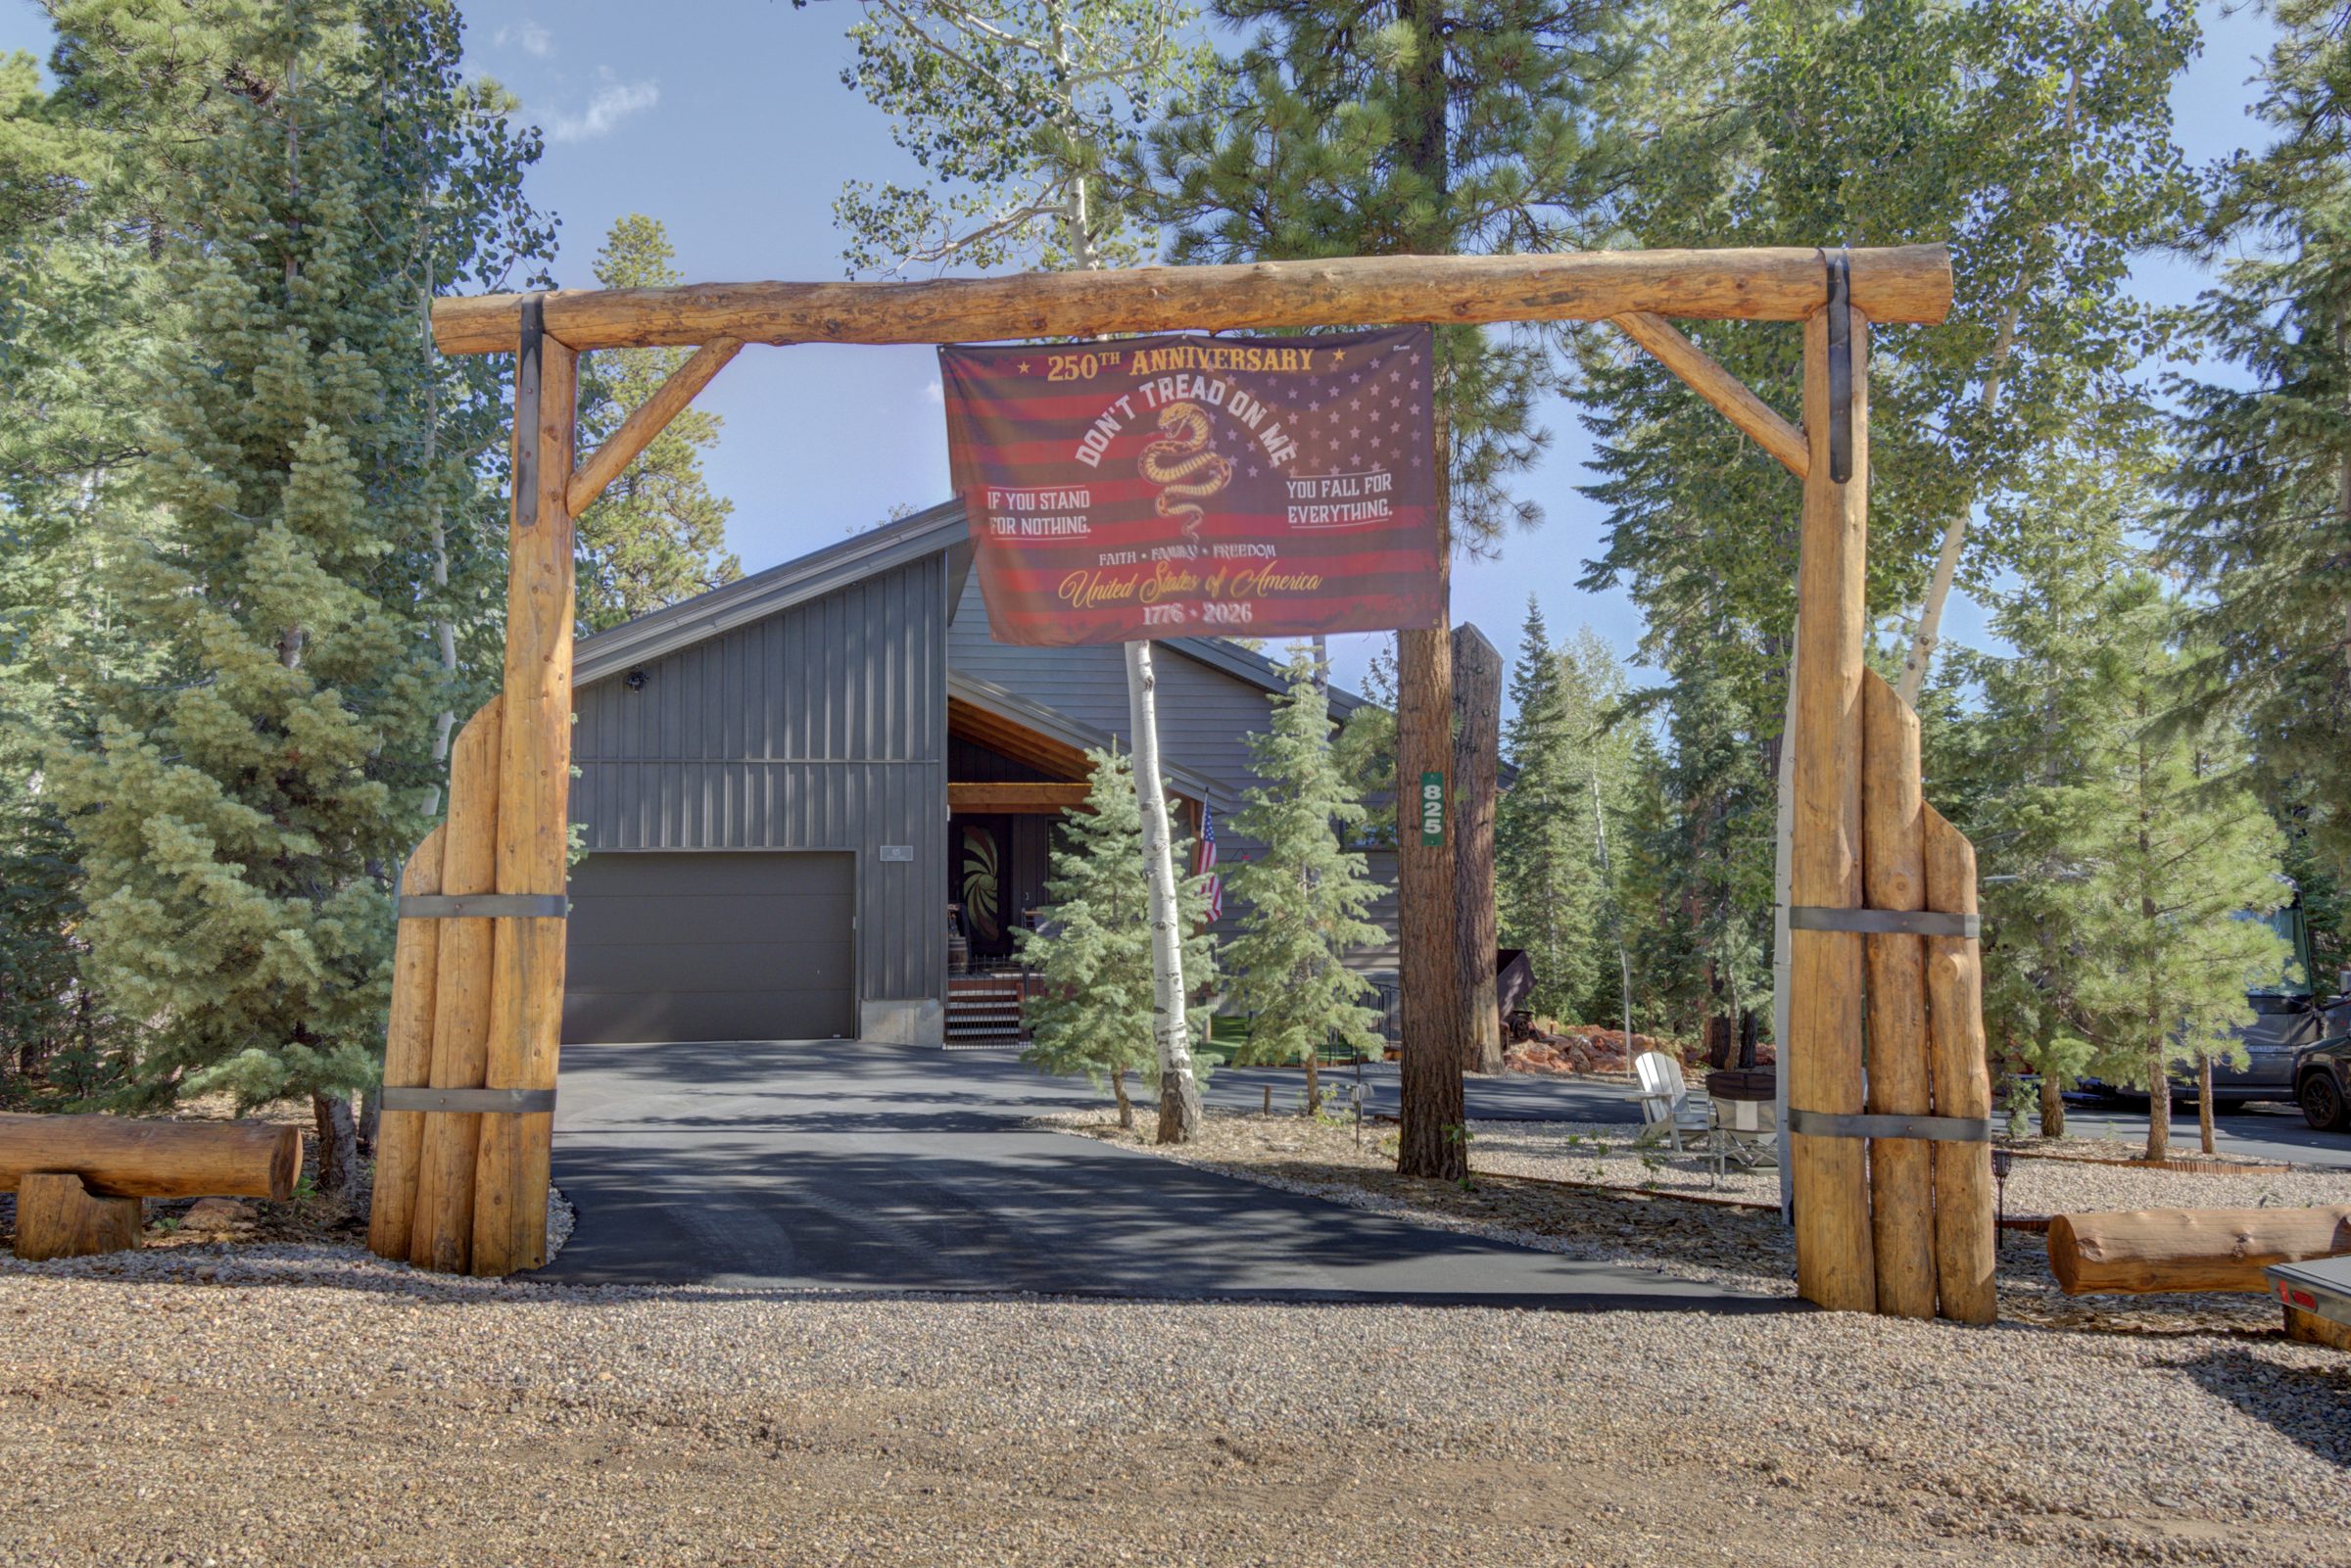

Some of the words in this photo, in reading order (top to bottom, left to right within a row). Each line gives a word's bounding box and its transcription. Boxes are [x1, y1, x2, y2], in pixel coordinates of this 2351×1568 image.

[1047, 351, 1122, 382] 250TH
[1128, 346, 1316, 377] ANNIVERSARY
[1075, 394, 1136, 468] DON'T
[1138, 373, 1226, 407] TREAD
[1227, 390, 1269, 430] ON
[1259, 422, 1297, 467] ME
[1286, 480, 1317, 499] YOU
[1321, 478, 1360, 499] FALL
[1365, 472, 1392, 495] FOR
[987, 491, 1001, 509] IF
[1006, 493, 1034, 510] YOU
[1039, 490, 1090, 509] STAND
[1287, 498, 1393, 524] EVERYTHING.
[989, 516, 1016, 535] FOR
[1021, 515, 1091, 536] NOTHING.
[1099, 550, 1136, 566] FAITH
[1213, 544, 1276, 561] FREEDOM
[1058, 570, 1138, 608] United
[1139, 559, 1201, 604] States
[1205, 565, 1227, 598] of
[1230, 559, 1322, 598] America
[1142, 602, 1185, 626] 1776
[1202, 601, 1253, 625] 2026
[1423, 784, 1442, 834] 825
